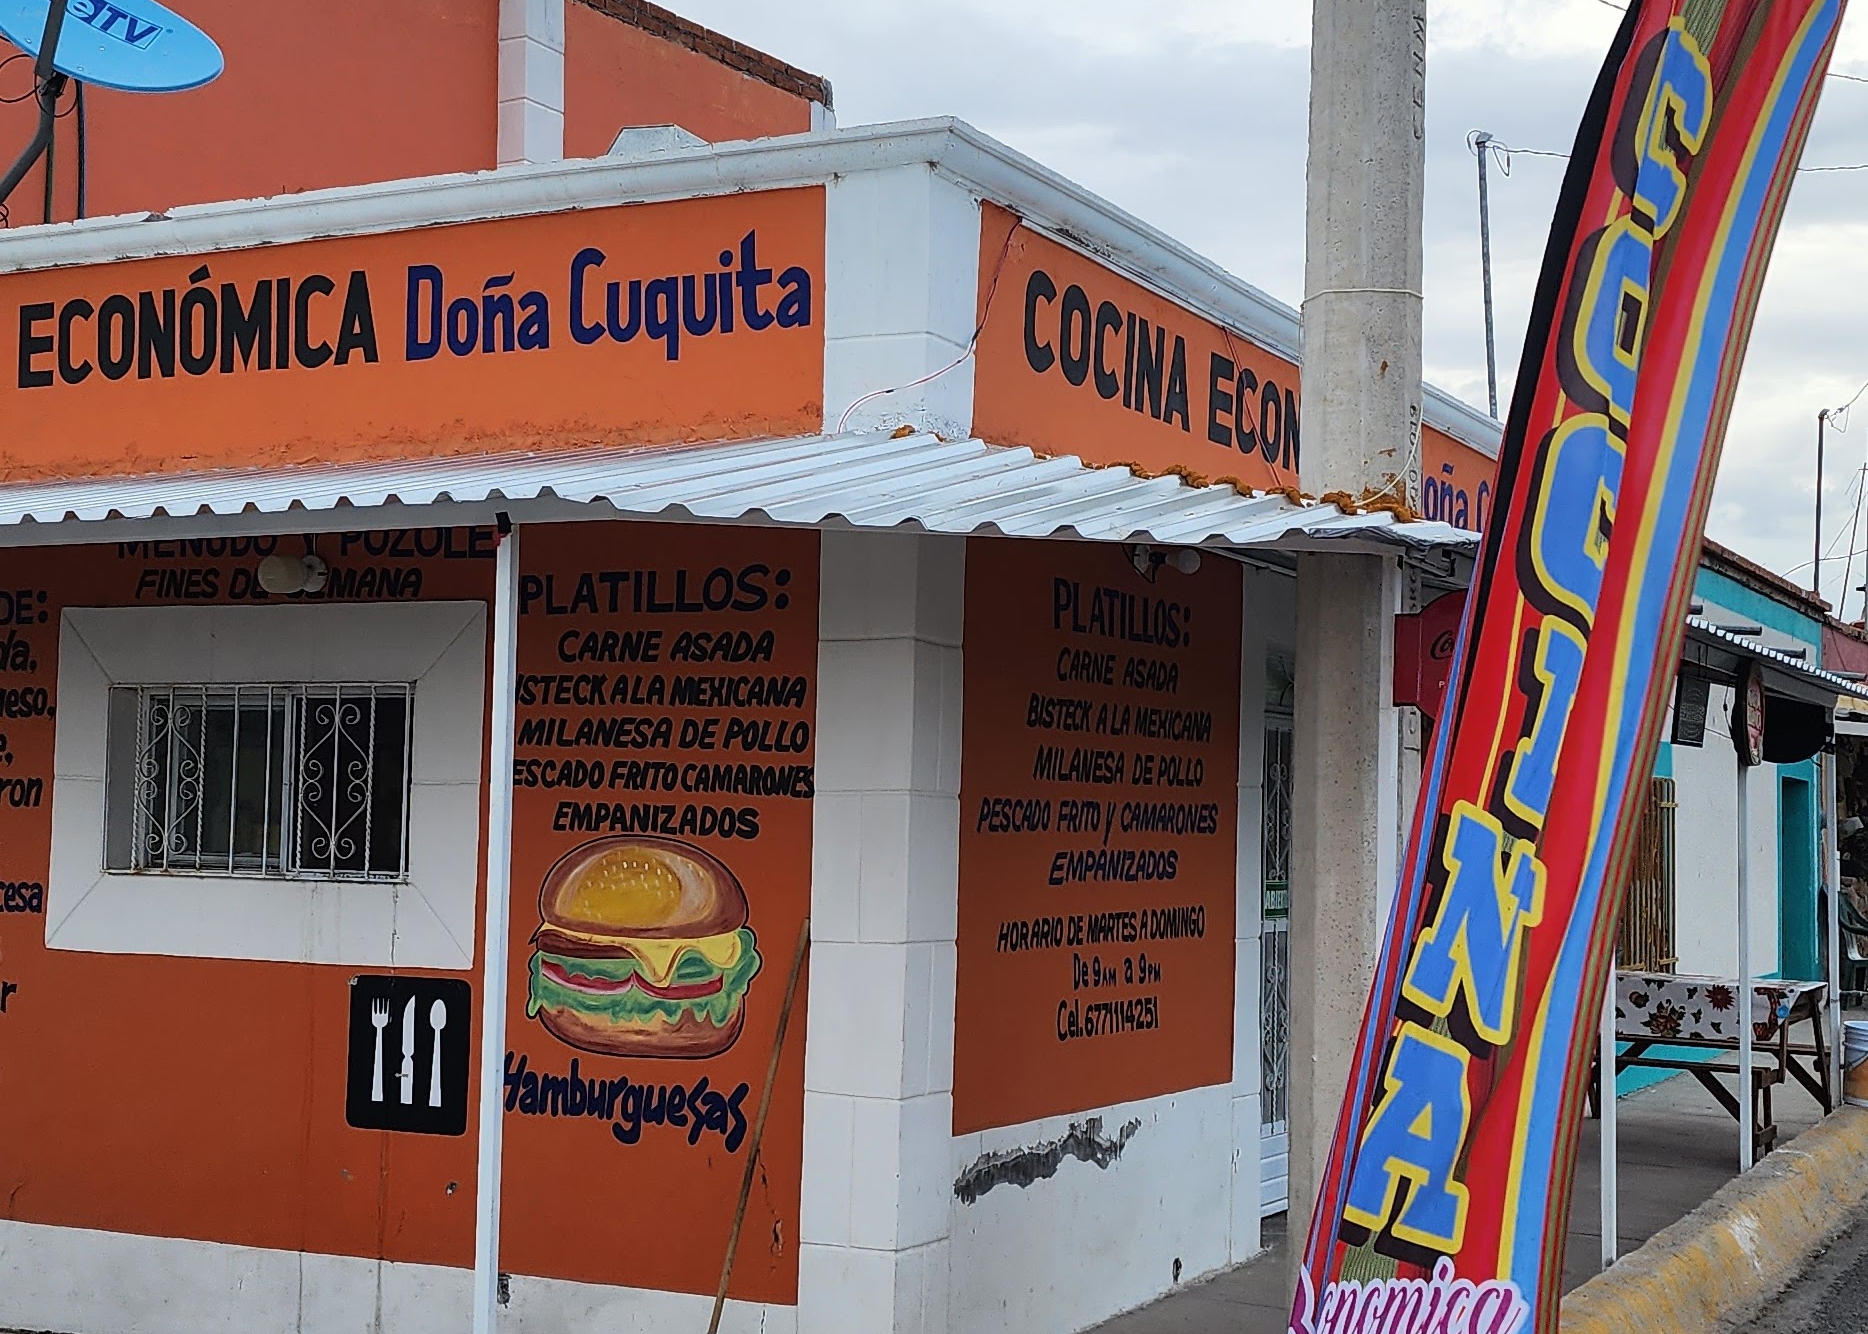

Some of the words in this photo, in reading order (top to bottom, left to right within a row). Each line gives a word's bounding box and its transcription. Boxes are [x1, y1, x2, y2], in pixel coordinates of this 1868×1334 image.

[18, 265, 379, 389] ECONÓMICA
[406, 265, 550, 362] Doña
[570, 229, 811, 361] Cuquita
[1024, 270, 1191, 433] COCINA
[1422, 462, 1468, 530] oña
[135, 568, 220, 599] FINES
[286, 567, 423, 599] MANA
[520, 564, 791, 615] PLATILLOS:
[1054, 577, 1191, 648] PLATILLOS:
[558, 630, 662, 663] CARNE
[670, 630, 775, 663] ASADA
[515, 674, 607, 706] ISTECK
[610, 675, 625, 705] A
[631, 675, 664, 706] LA
[669, 675, 807, 708] MEXICANA
[1056, 647, 1116, 685] CARNE
[1122, 657, 1179, 694] ASADA
[518, 717, 673, 749] MILANESA
[678, 718, 720, 750] DE
[722, 717, 809, 753] POLLO
[1026, 692, 1093, 733] BISTECK
[1096, 703, 1107, 734] A
[1110, 704, 1131, 736] LA
[1134, 705, 1212, 742] MEXICANA
[513, 759, 607, 789] ESCADO
[608, 760, 678, 791] FRITO
[681, 762, 816, 799] CAMARONES
[1033, 744, 1125, 784] MILANESA
[1132, 753, 1154, 785] DE
[1157, 755, 1203, 787] POLLO
[553, 802, 760, 839] EMPANIZADOS
[976, 797, 1050, 834] PESCADO
[1057, 800, 1100, 833] FRITO
[1120, 801, 1218, 835] CAMARONES
[1049, 848, 1178, 886] EMPANIZADOS
[997, 916, 1063, 953] HORARIO
[1066, 915, 1084, 947] DE
[1086, 911, 1137, 944] MARTES
[1139, 909, 1148, 940] A
[1150, 904, 1205, 940] DOMINGO
[1073, 952, 1089, 991] De
[503, 1051, 749, 1153] Hamburguesas
